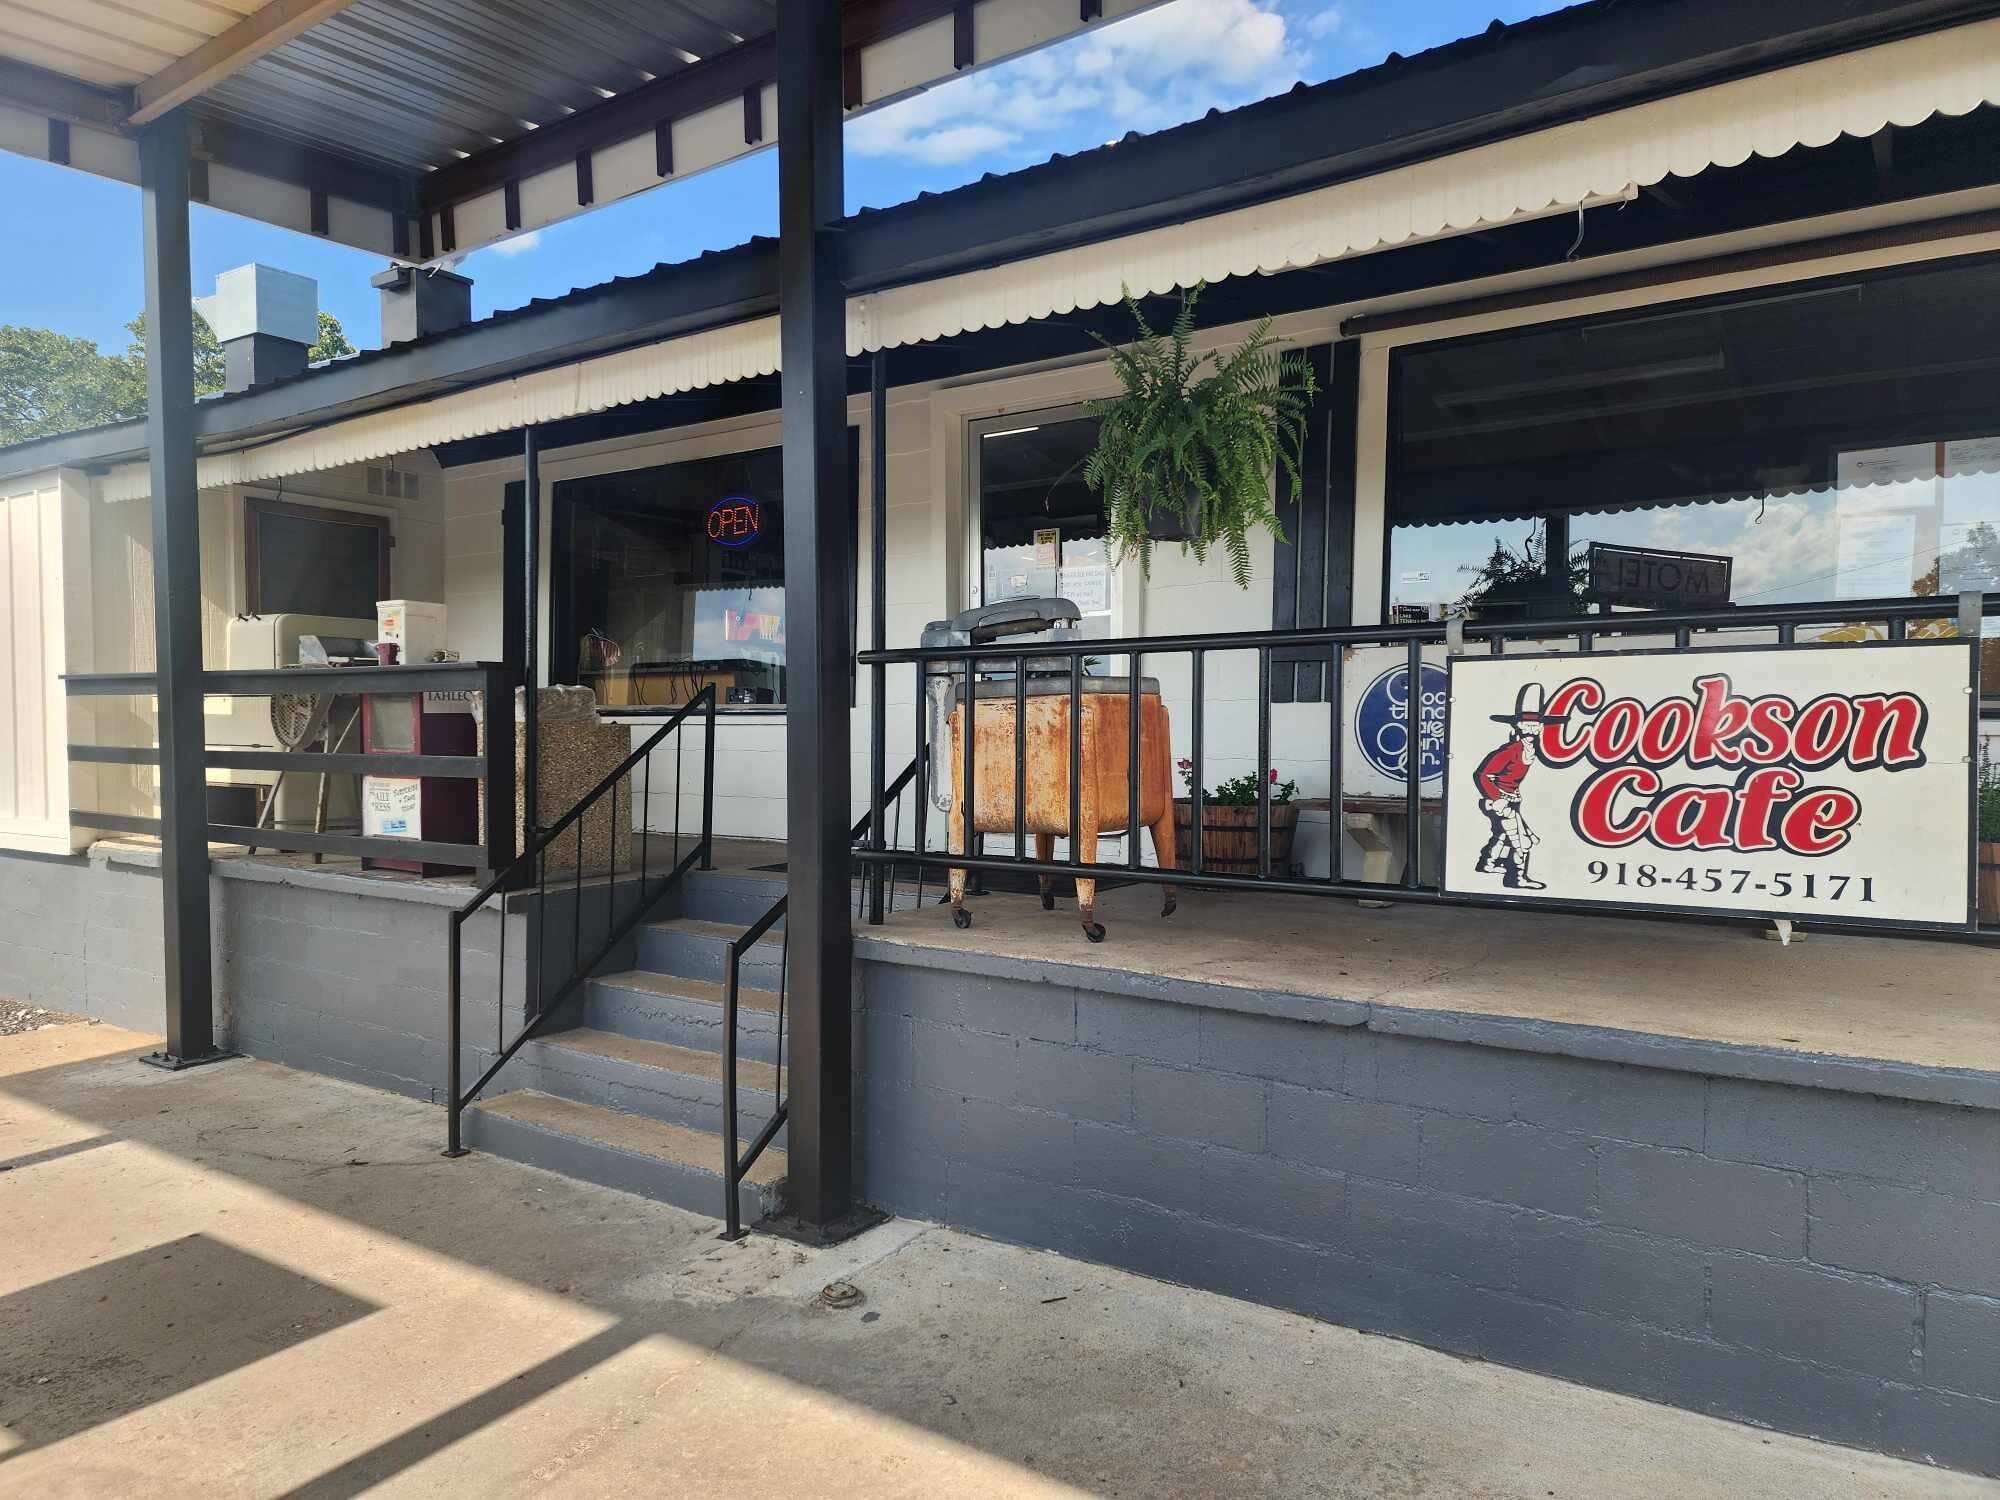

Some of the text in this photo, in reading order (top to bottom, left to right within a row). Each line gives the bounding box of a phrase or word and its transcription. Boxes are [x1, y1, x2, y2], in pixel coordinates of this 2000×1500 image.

[708, 504, 759, 538] OPEN
[1539, 674, 1927, 771] Cookson
[1570, 765, 1861, 857] Cafe
[1588, 860, 1877, 903] 918-457-5171
